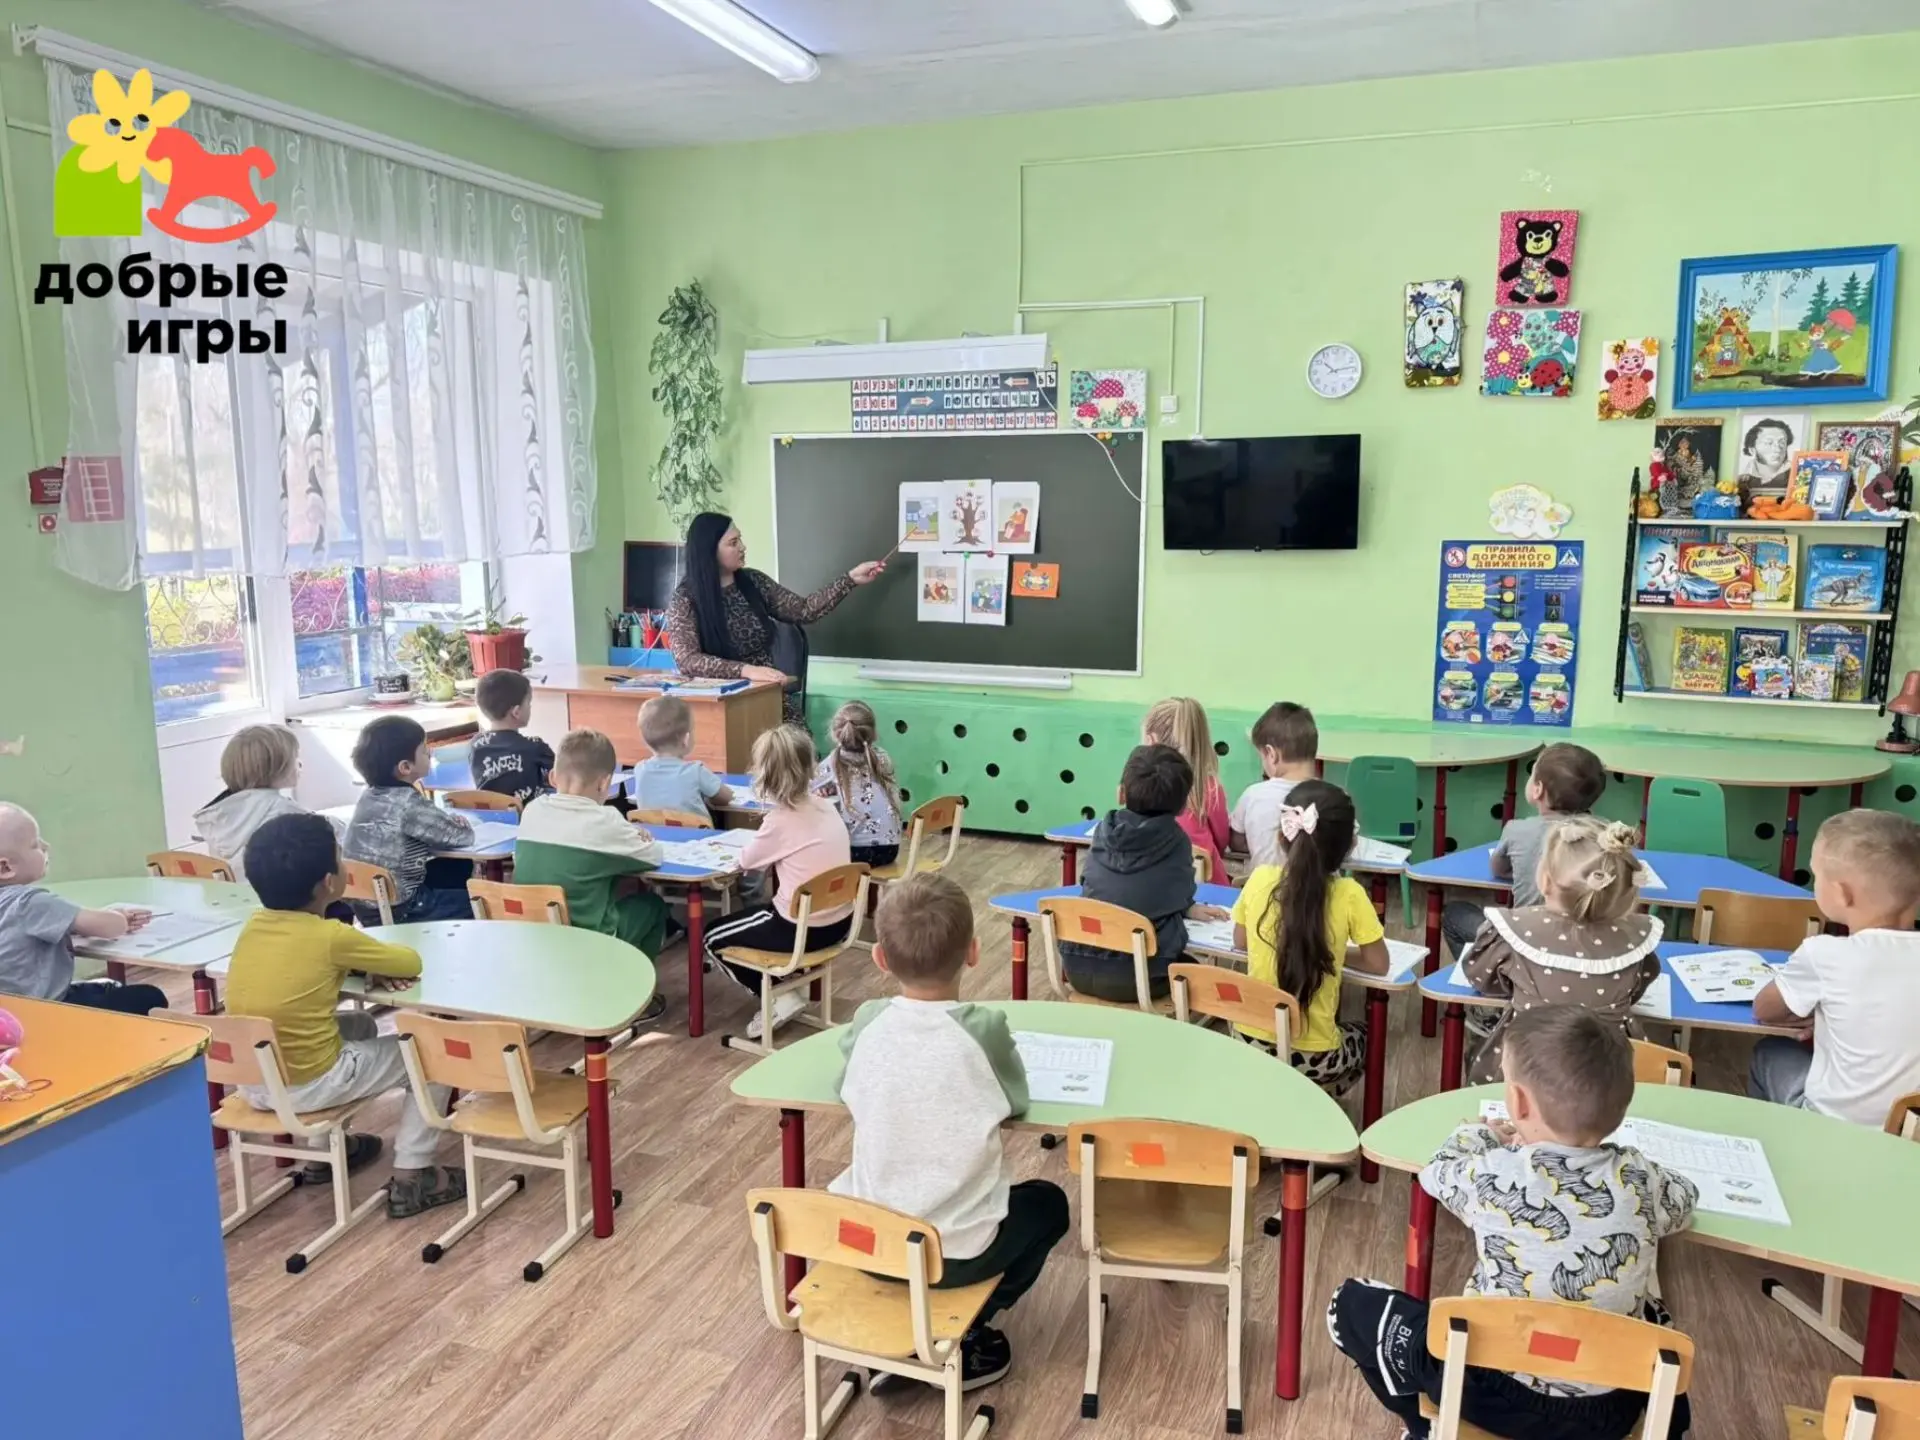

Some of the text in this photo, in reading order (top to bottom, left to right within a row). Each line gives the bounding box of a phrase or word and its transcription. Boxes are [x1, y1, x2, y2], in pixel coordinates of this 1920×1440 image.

[1484, 545, 1537, 553] ПРАВИЛА
[1472, 553, 1552, 561] ДОРОЖНОГО
[482, 753, 524, 777] ENJOY
